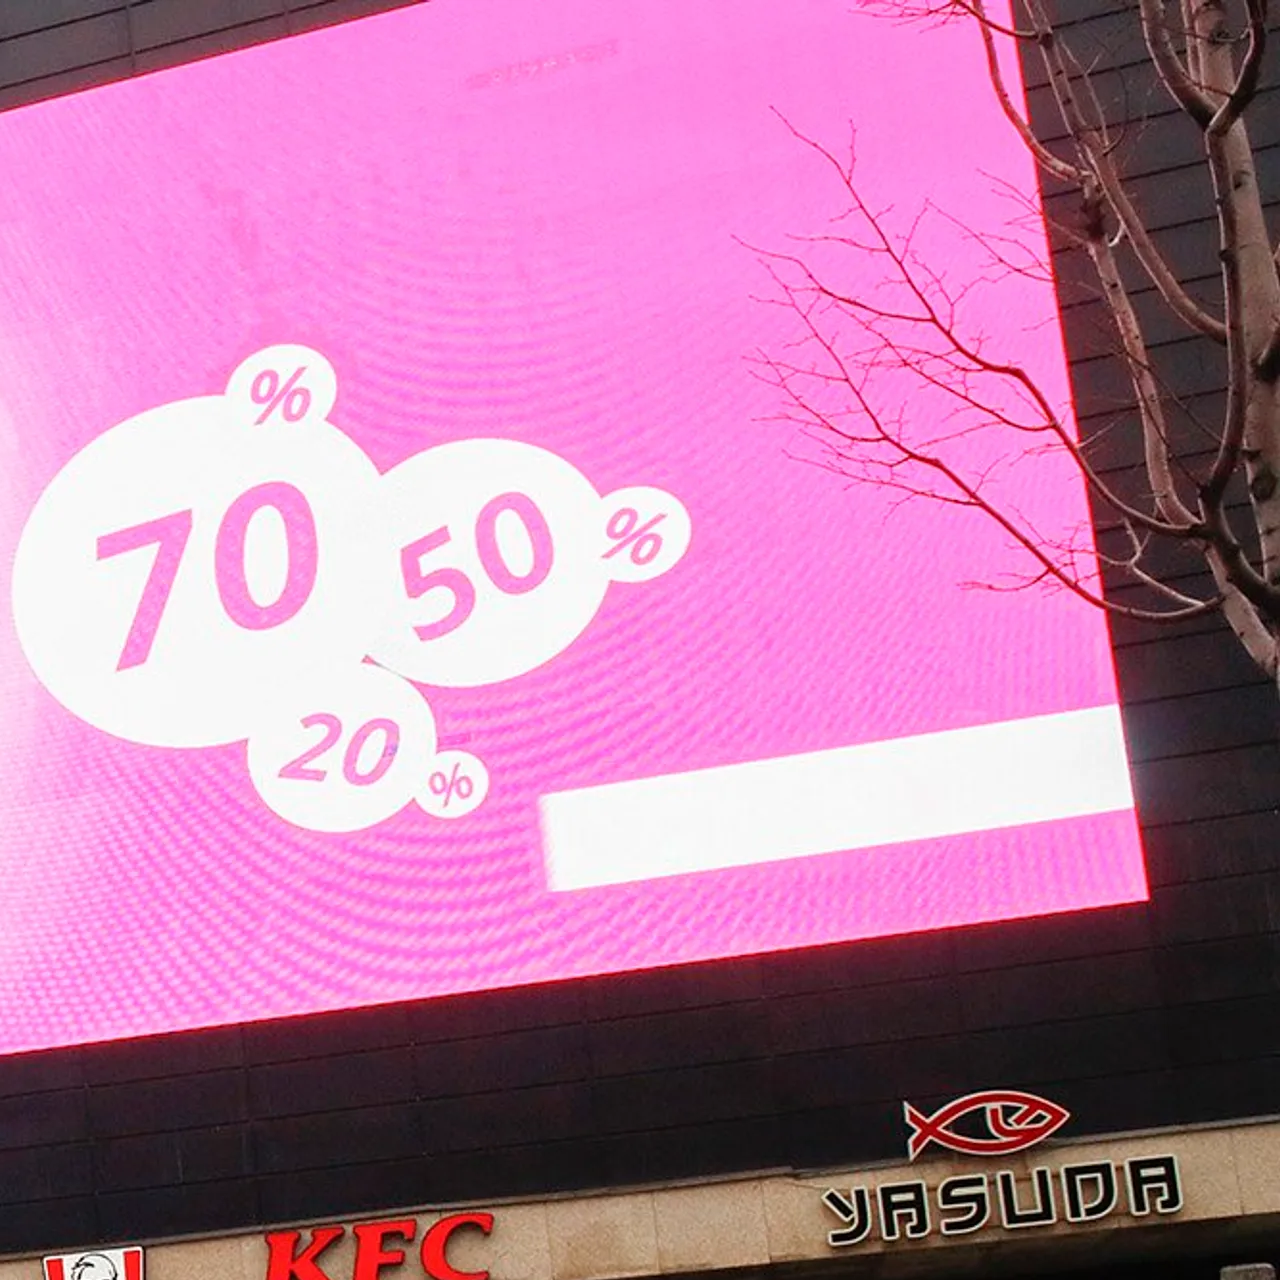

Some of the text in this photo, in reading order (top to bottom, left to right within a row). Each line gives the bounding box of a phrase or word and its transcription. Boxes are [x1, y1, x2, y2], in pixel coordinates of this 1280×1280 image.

[250, 366, 311, 426] %
[400, 491, 554, 641] 50
[601, 508, 667, 565] %
[96, 481, 318, 672] 70
[278, 713, 400, 786] 20
[429, 762, 473, 808] %
[822, 1154, 1183, 1246] YASUDA
